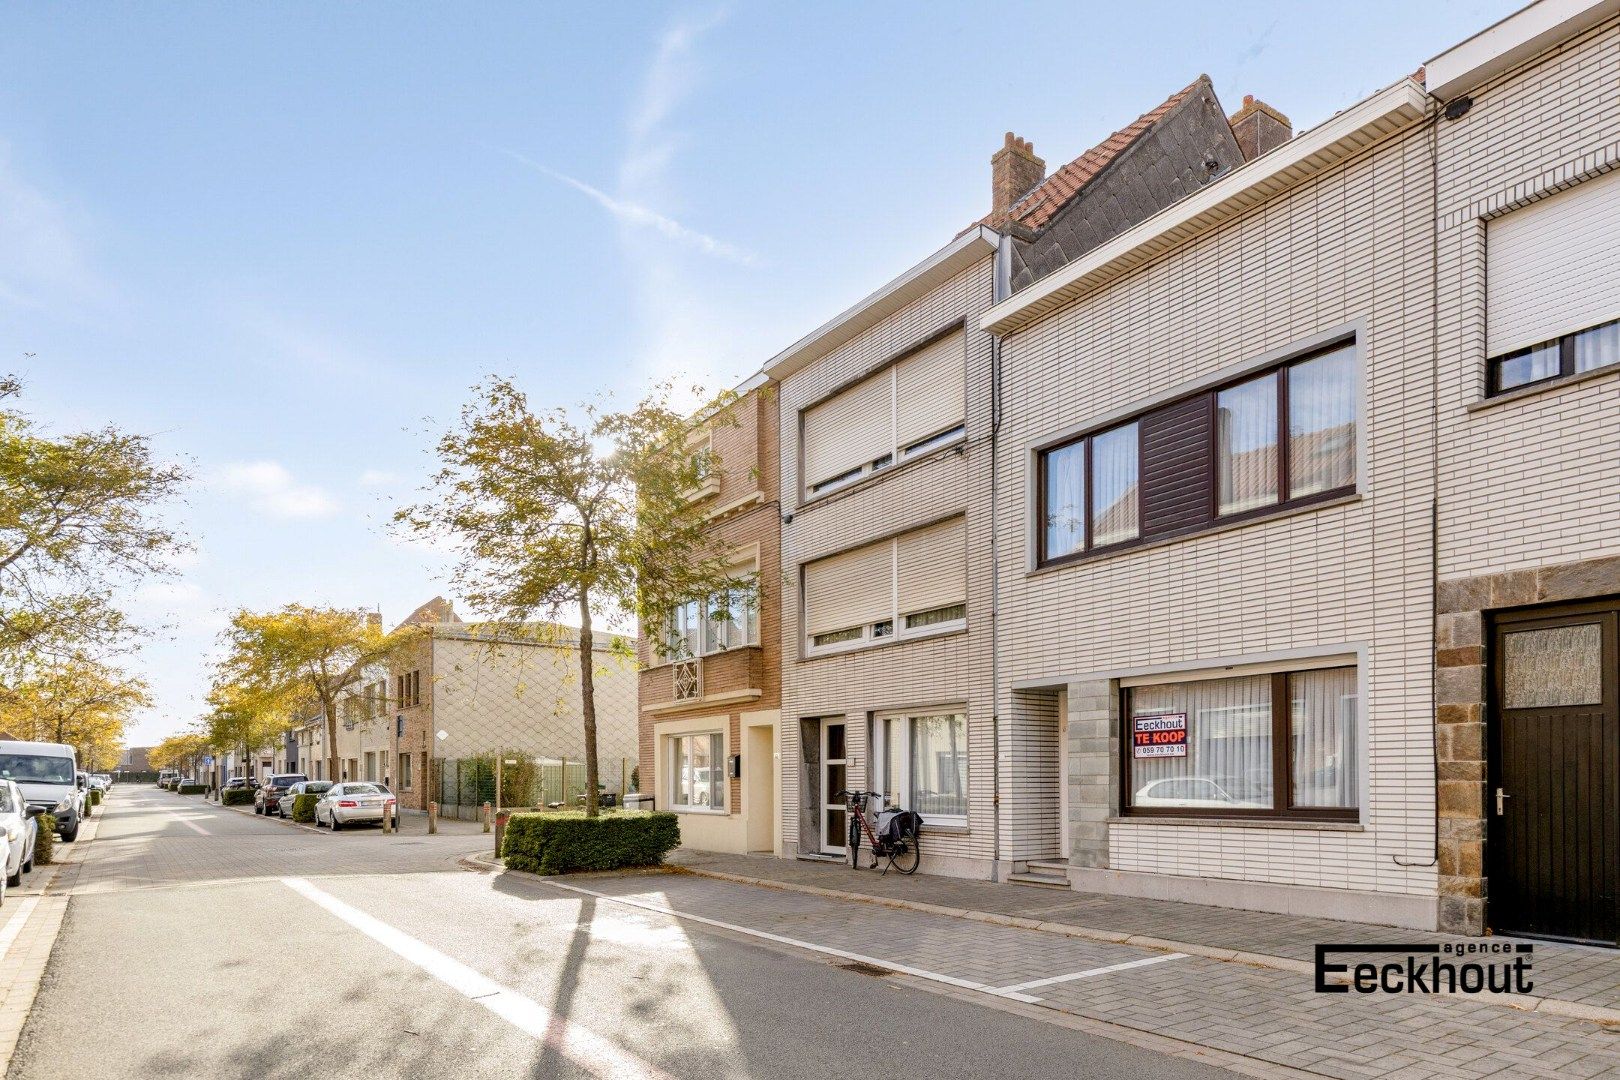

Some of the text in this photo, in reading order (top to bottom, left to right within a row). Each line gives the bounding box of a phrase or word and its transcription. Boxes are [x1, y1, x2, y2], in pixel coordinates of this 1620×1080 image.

[1136, 717, 1183, 730] Eeckhout
[1135, 731, 1185, 744] TE KOOP
